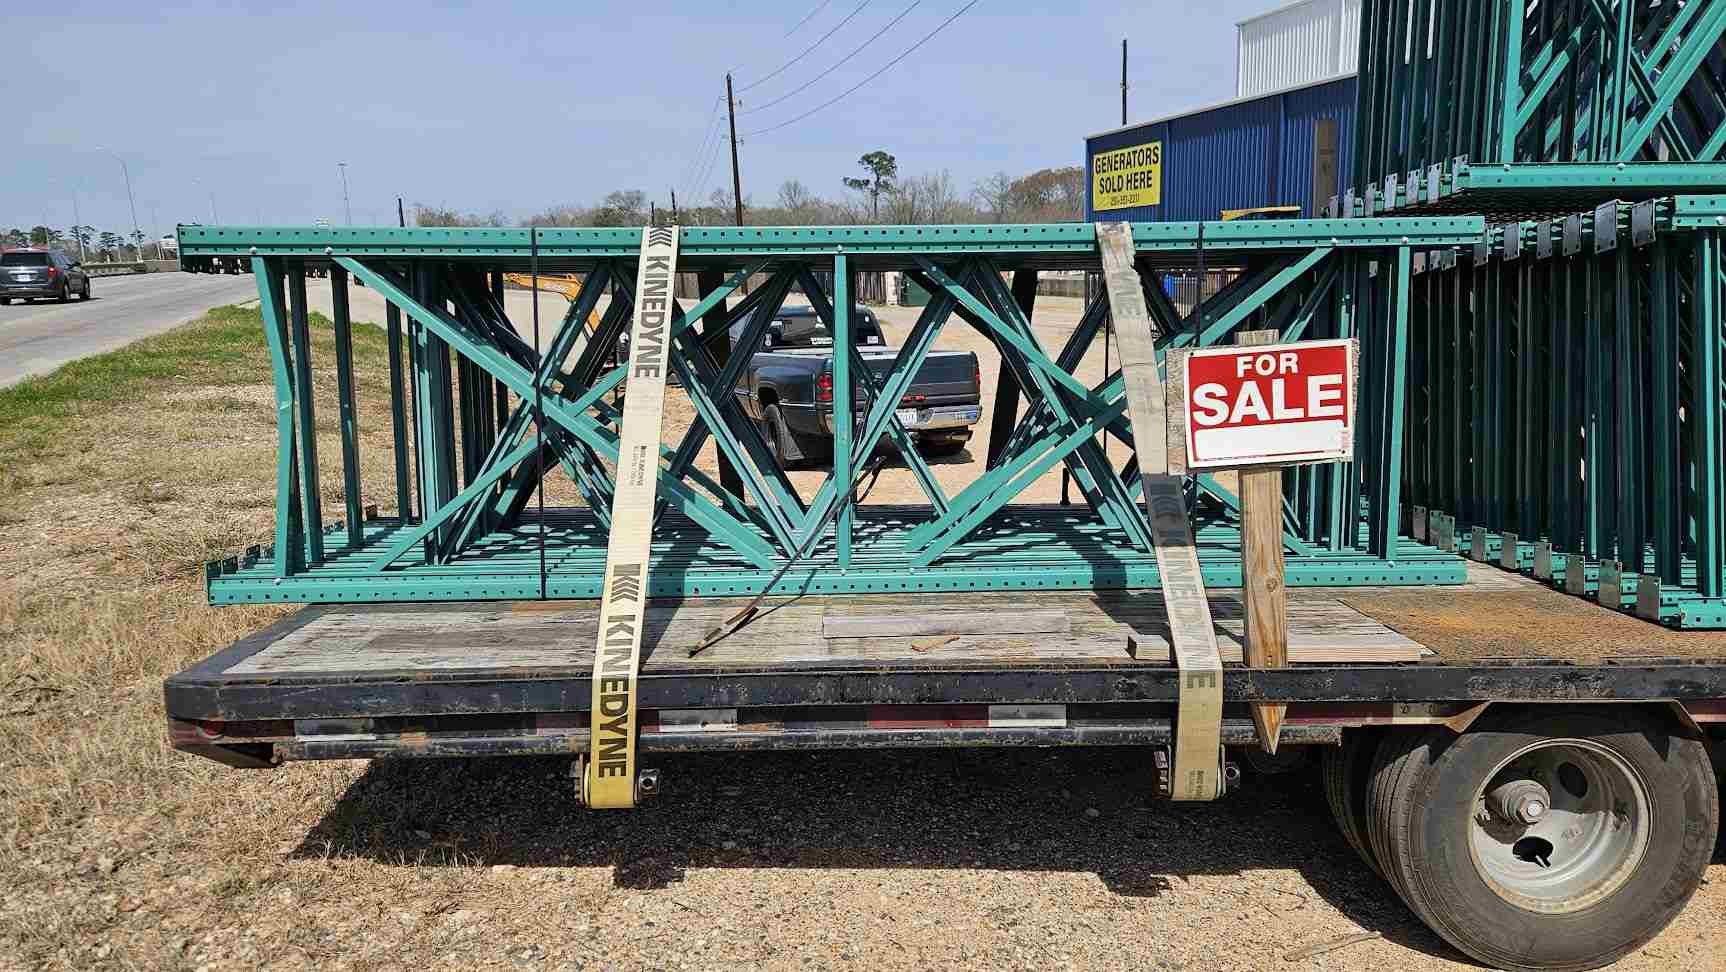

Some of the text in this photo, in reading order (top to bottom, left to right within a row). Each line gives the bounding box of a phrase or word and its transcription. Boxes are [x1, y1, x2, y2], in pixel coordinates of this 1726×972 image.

[1095, 145, 1159, 175] GENERATORS
[1099, 170, 1152, 194] SOLD HERE
[634, 255, 670, 378] KINEDYNE
[1236, 352, 1298, 378] FOR
[1192, 373, 1344, 425] SALE
[598, 614, 636, 778] KINEDYNE
